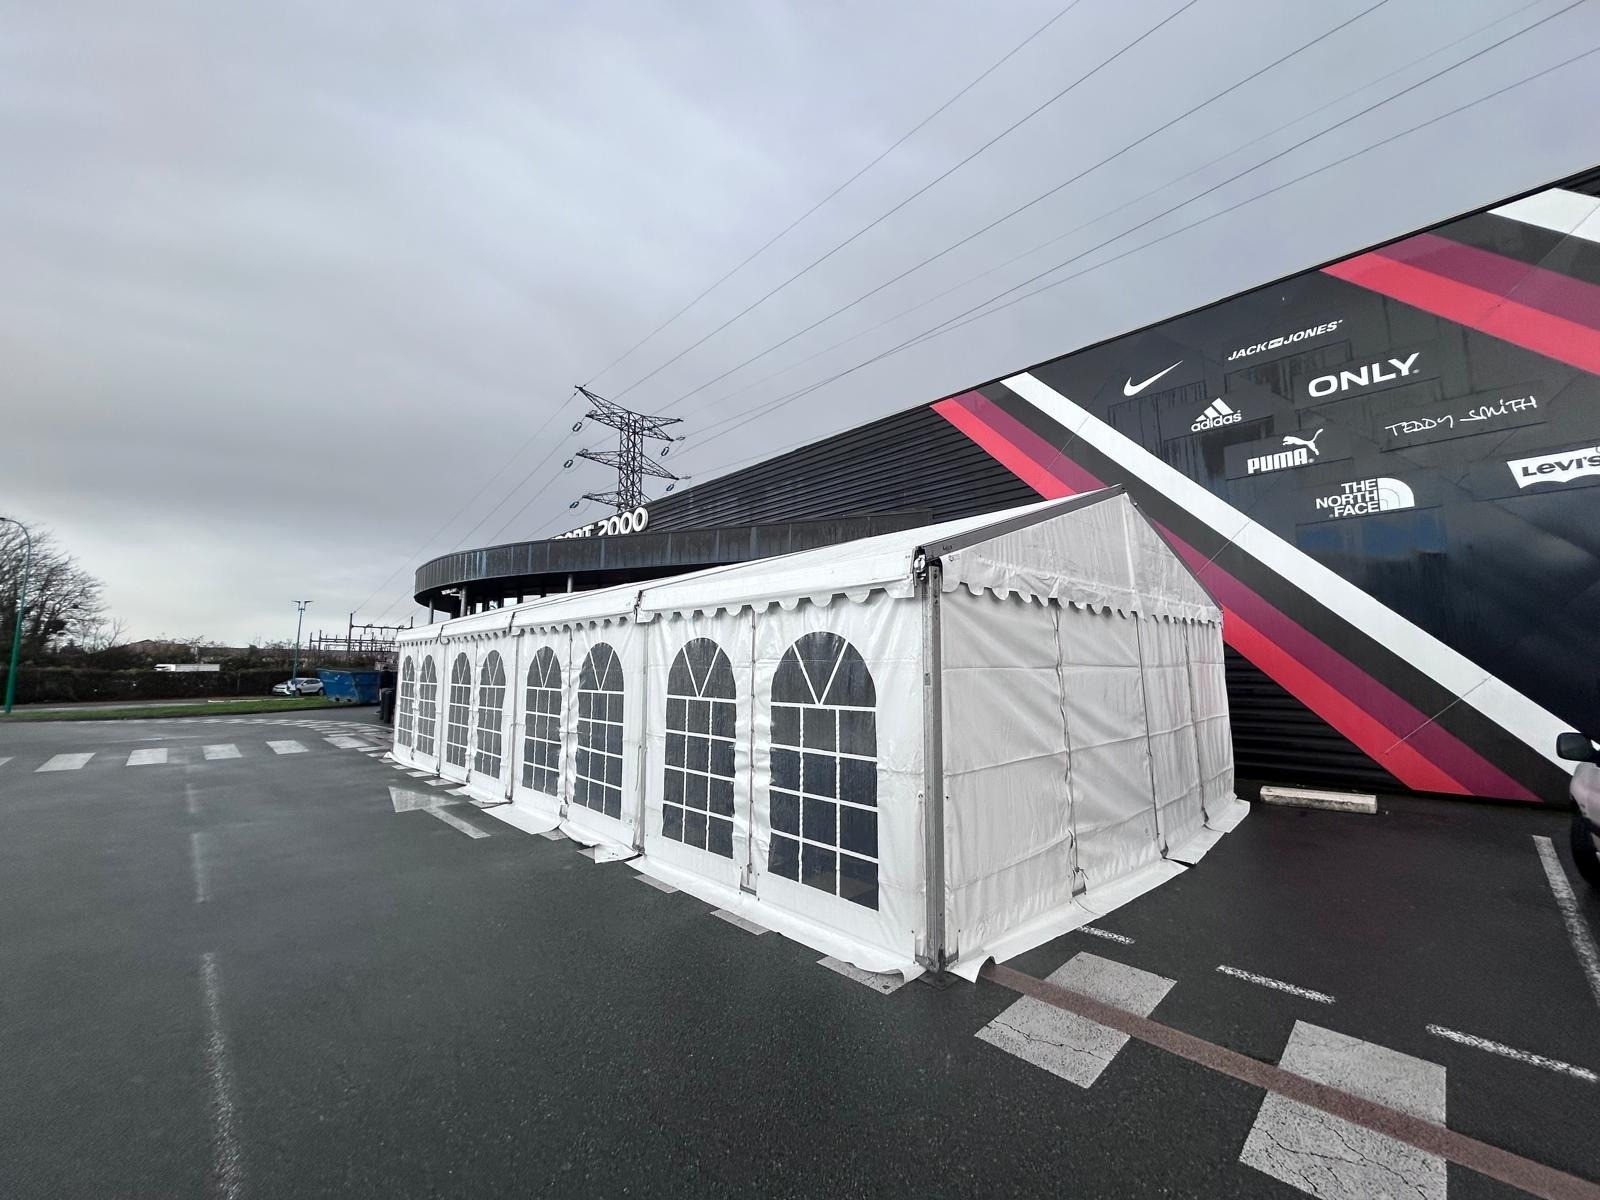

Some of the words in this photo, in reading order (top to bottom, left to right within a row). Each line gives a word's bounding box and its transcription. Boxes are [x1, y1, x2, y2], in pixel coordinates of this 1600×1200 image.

[1308, 352, 1419, 397] ONLY
[1191, 411, 1242, 432] adidas
[1385, 415, 1453, 436] TEDDY
[1247, 447, 1308, 475] PUMA
[1341, 478, 1377, 494] THE
[1315, 490, 1378, 510] NORTH
[1334, 501, 1380, 518] FACE
[598, 507, 649, 537] 2000
